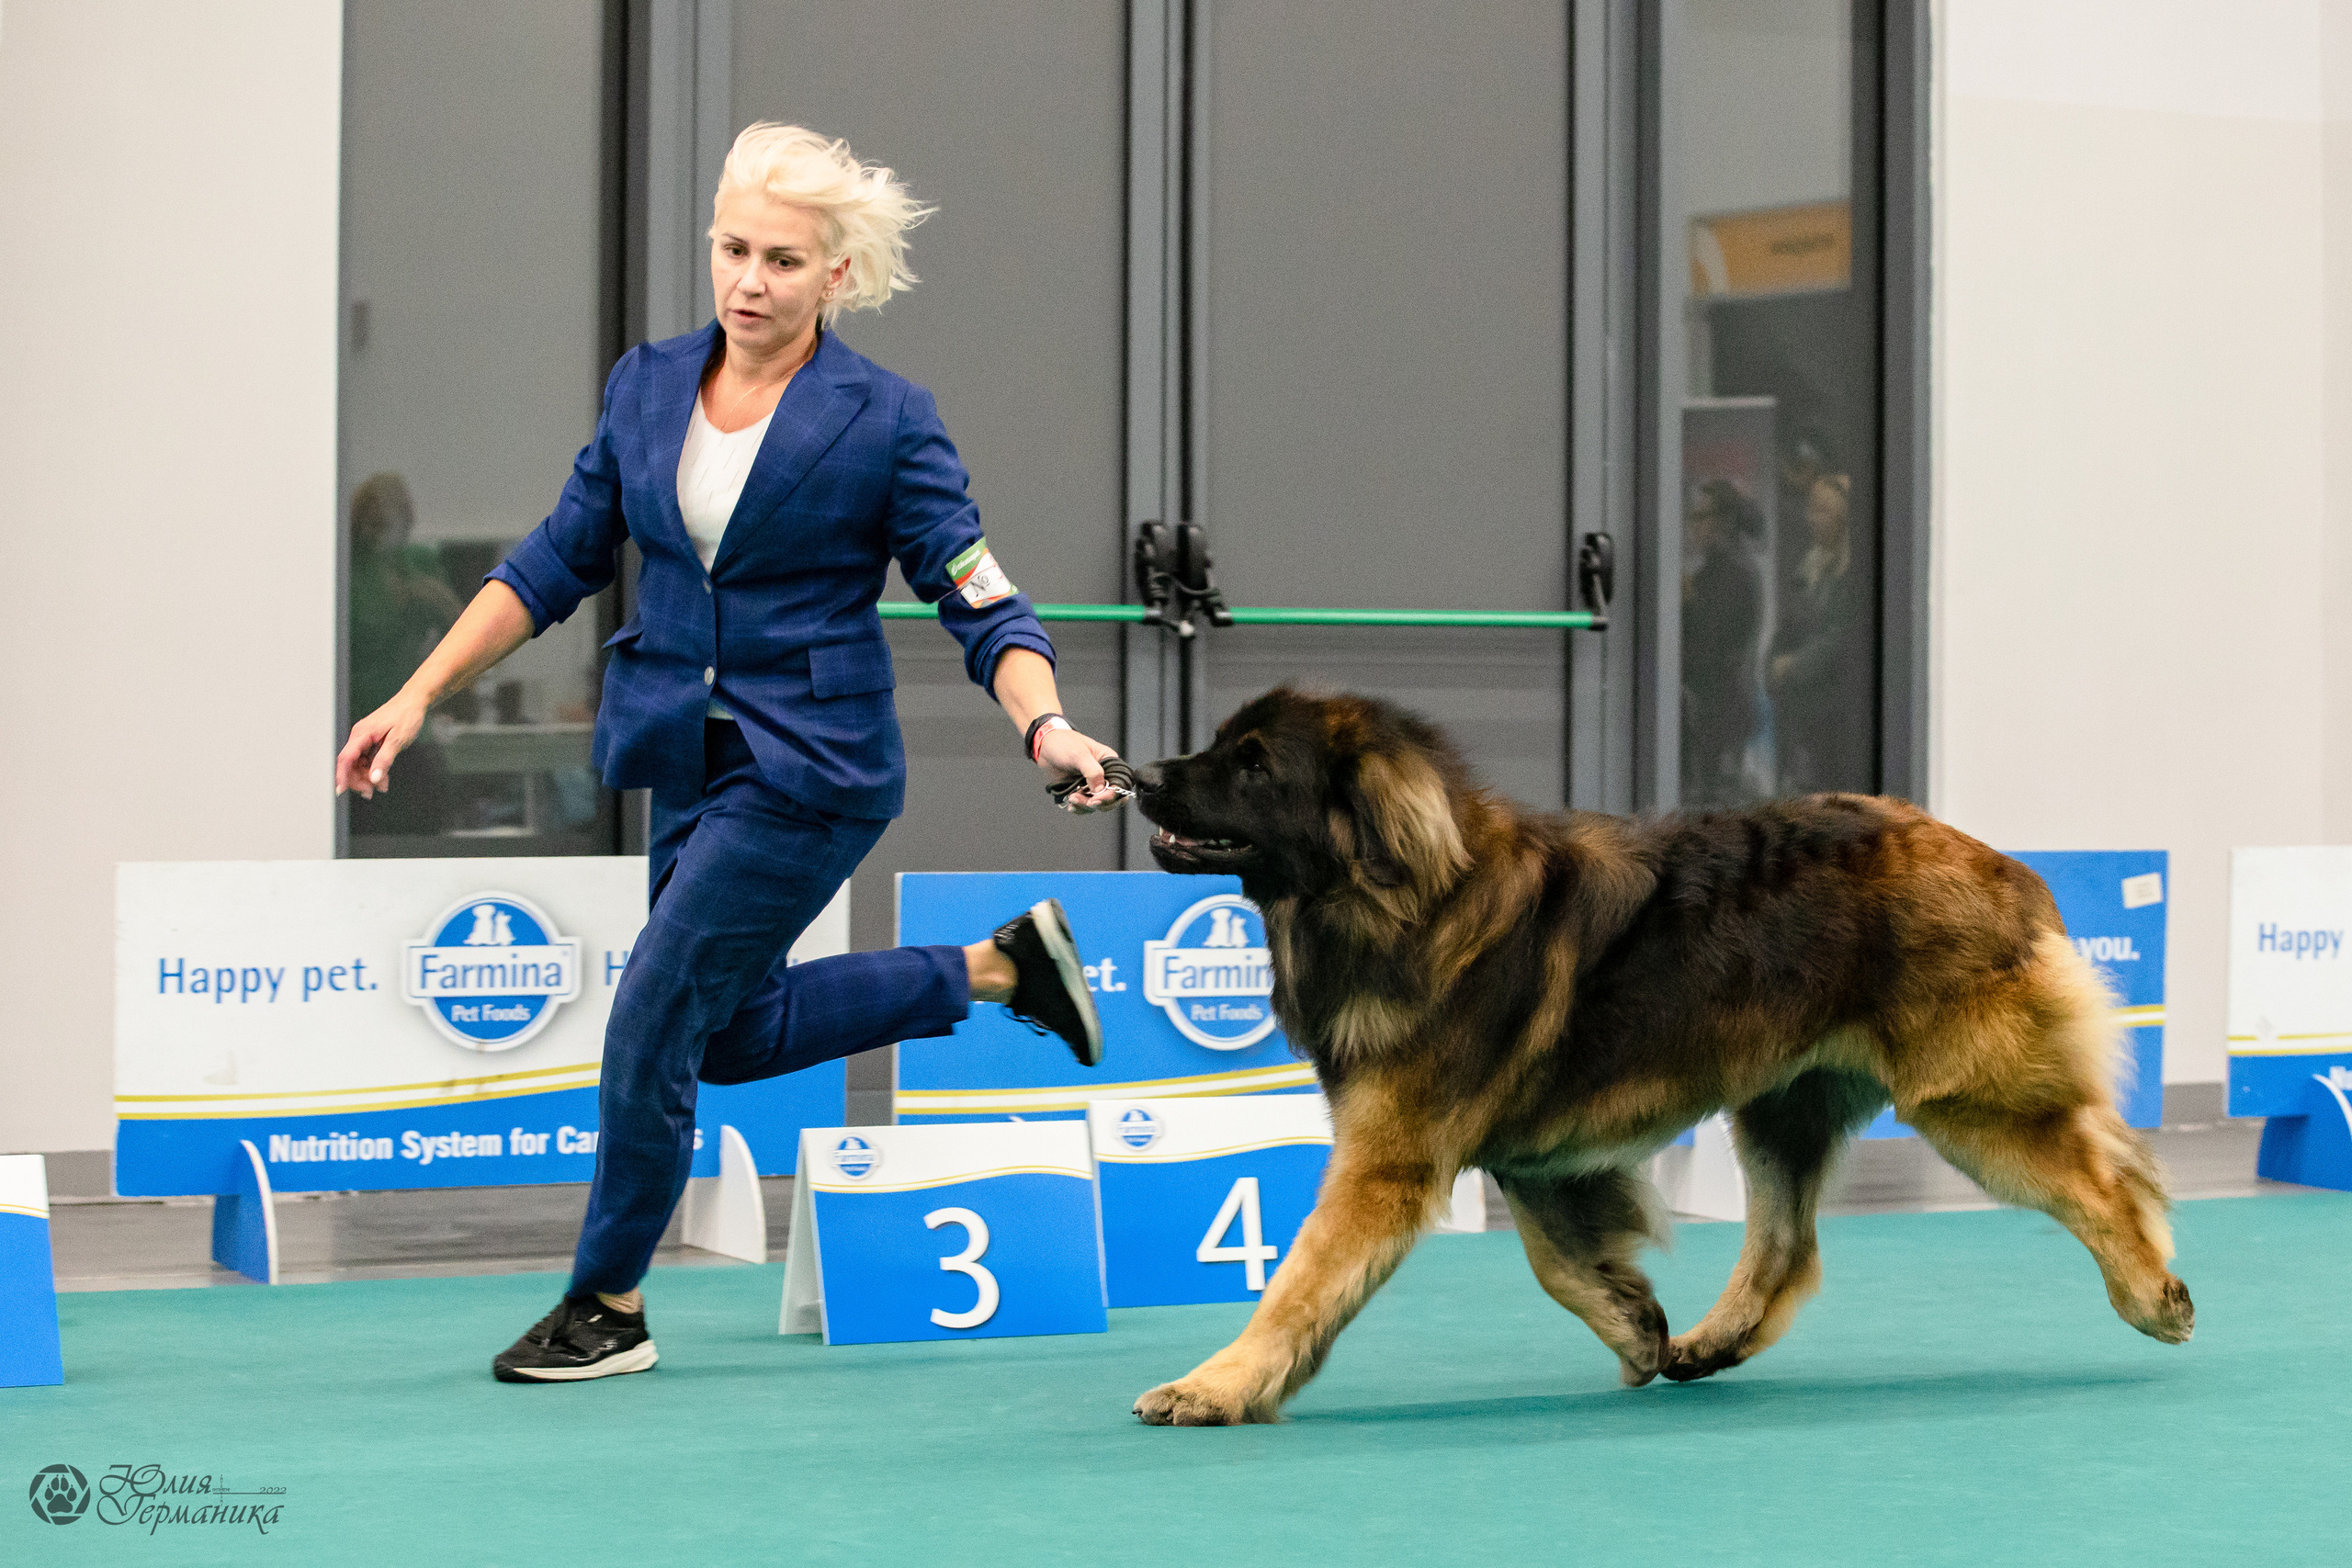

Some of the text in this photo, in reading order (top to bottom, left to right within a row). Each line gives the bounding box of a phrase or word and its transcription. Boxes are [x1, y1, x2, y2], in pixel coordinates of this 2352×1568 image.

[2257, 922, 2345, 961] Happy
[158, 957, 379, 1004] Happy pet.
[420, 953, 562, 989] Farmina
[1082, 957, 1127, 992] et.
[1162, 954, 1273, 989] Farmin
[451, 1003, 531, 1021] Pet Foods
[269, 1131, 394, 1163] Nutrition
[401, 1129, 503, 1166] System
[509, 1127, 551, 1156] for
[1196, 1177, 1279, 1292] 4
[923, 1206, 1000, 1329] 3
